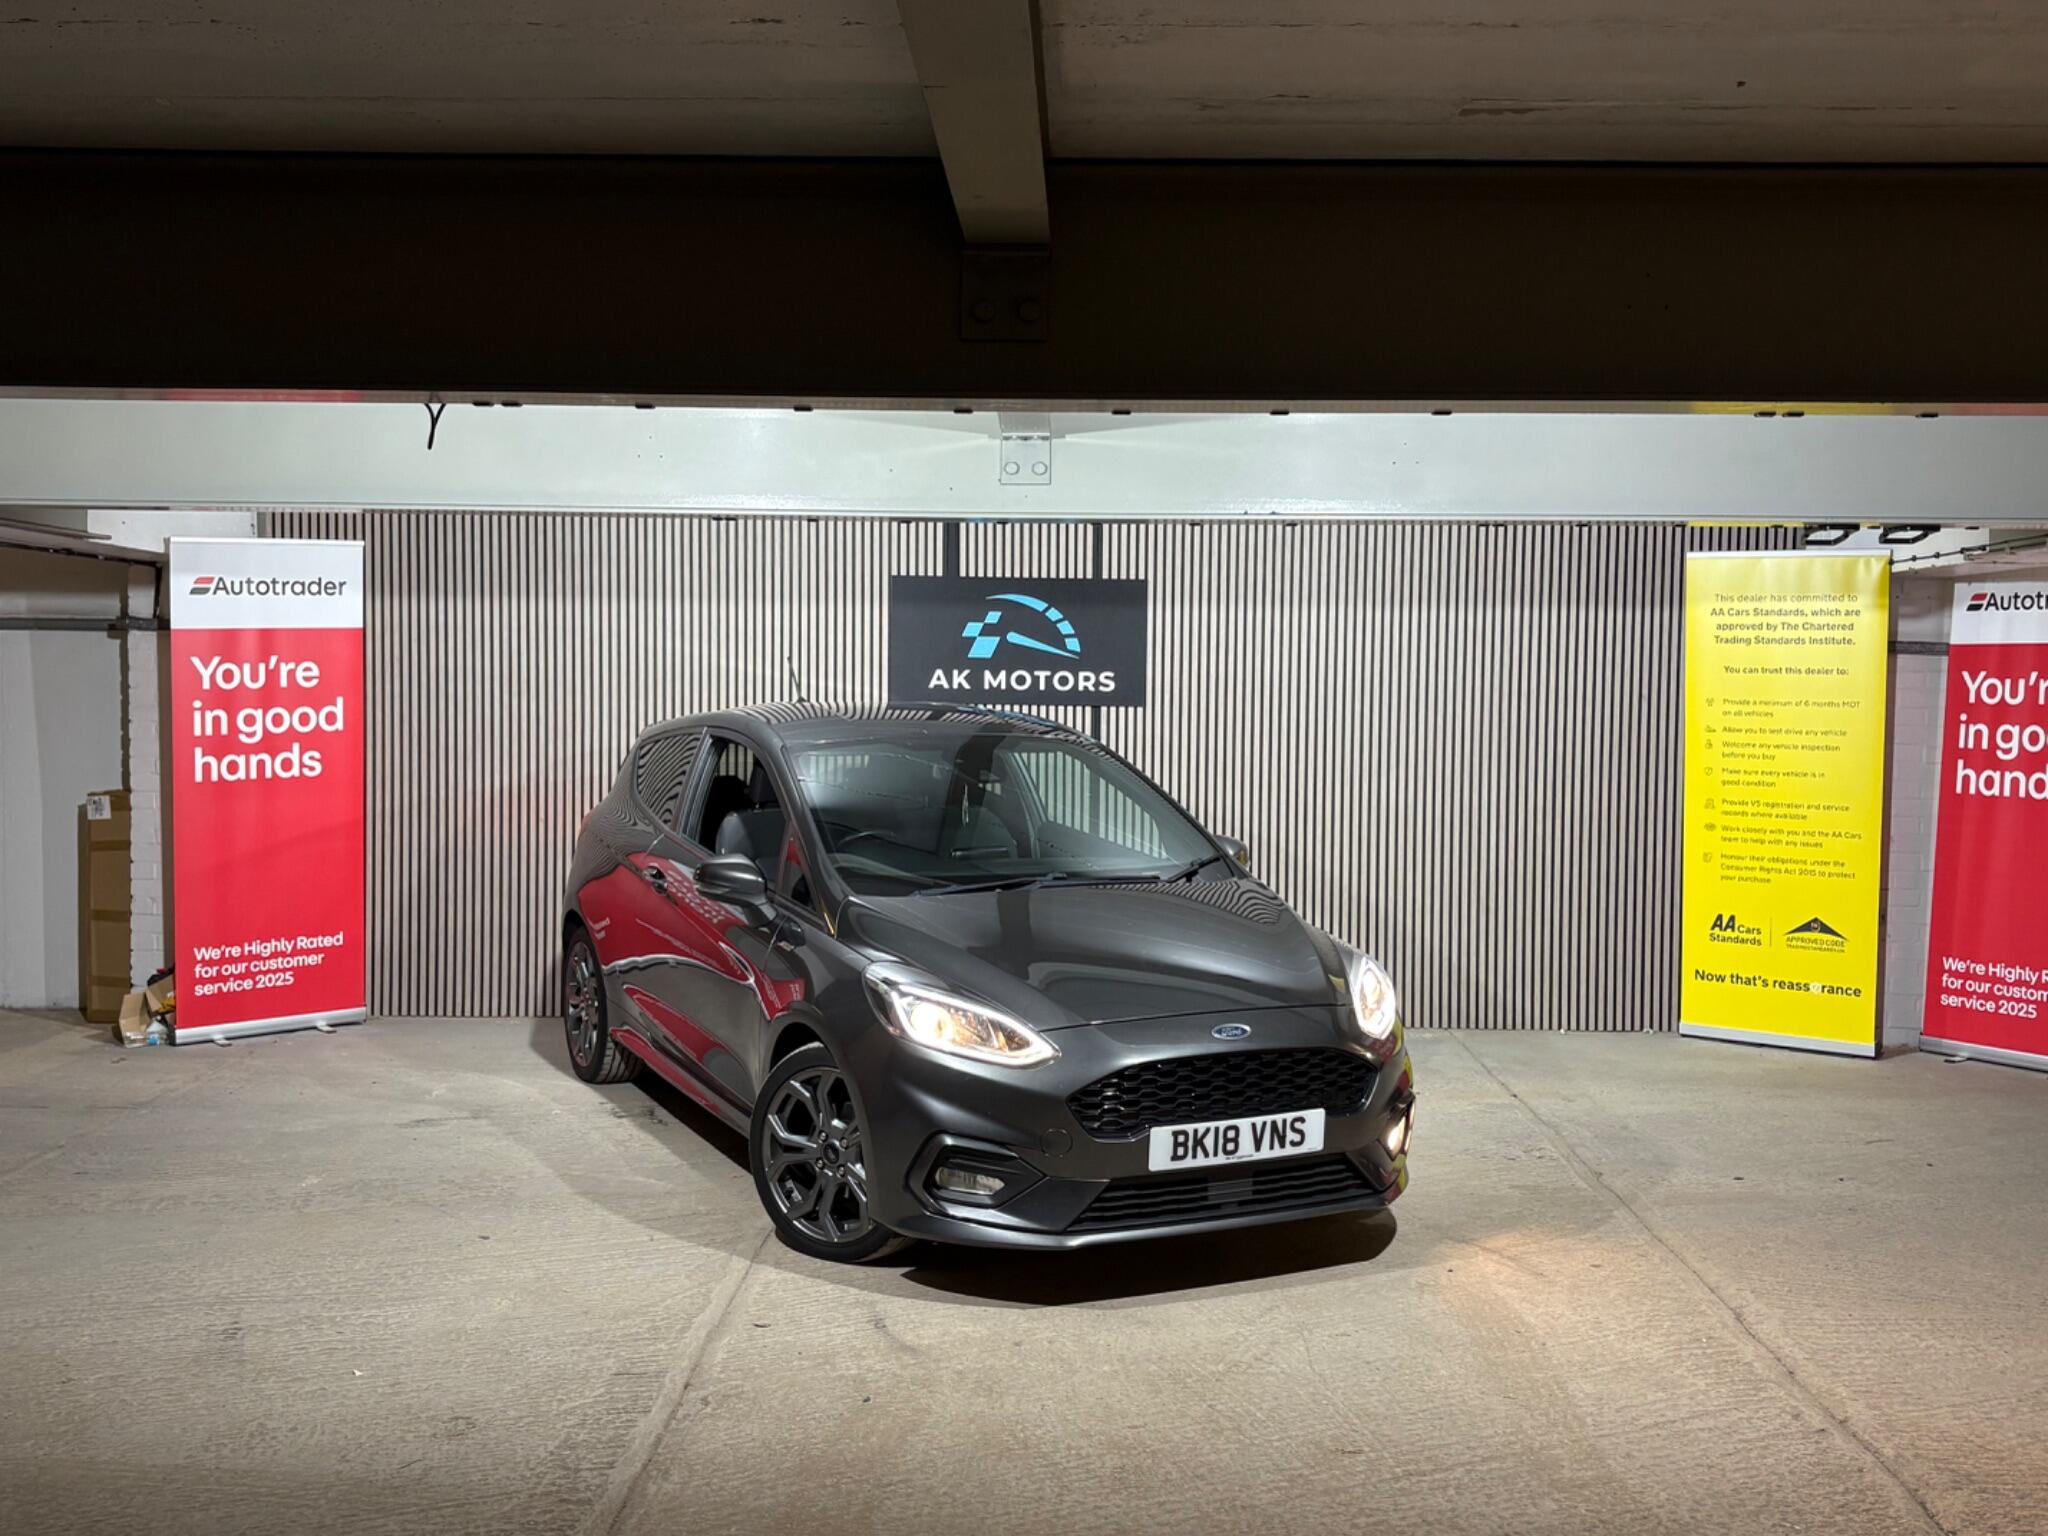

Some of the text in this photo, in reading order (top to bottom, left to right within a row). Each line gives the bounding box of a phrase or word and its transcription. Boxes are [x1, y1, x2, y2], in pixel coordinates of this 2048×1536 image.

[213, 577, 347, 596] Autotrader
[1714, 594, 1735, 602] This
[1737, 594, 1768, 602] dealer
[1771, 594, 1787, 602] has
[1791, 594, 1844, 602] committed
[1728, 608, 1750, 616] Cars
[1753, 608, 1808, 617] Standards,
[1716, 622, 1854, 631] approved by The Chartered
[1714, 635, 1856, 646] Trading Standards Institute.
[190, 655, 320, 690] You're
[928, 669, 1115, 691] AK MOTORS
[1724, 666, 1740, 674] You
[1785, 667, 1802, 675] this
[1805, 667, 1834, 675] dealer
[193, 696, 343, 744] in good
[1959, 713, 2048, 760] in go
[1759, 742, 1771, 750] any
[1773, 742, 1799, 750] vehicle
[1801, 743, 1840, 752] inspection
[1762, 753, 1775, 761] buy
[195, 742, 322, 783] hands
[1722, 799, 1748, 807] Provide
[1763, 801, 1804, 811] registration
[1823, 804, 1850, 812] service
[1743, 826, 1767, 834] closely
[1844, 832, 1862, 840] Cars
[1711, 913, 1761, 935] AA Cars
[194, 931, 343, 960] We're Highly Rated
[1709, 932, 1761, 946] Standards
[195, 953, 324, 978] for our customer
[1943, 957, 1985, 975] We're
[1989, 963, 2039, 985] Highly
[194, 972, 294, 996] service 2025
[1695, 969, 1726, 982] Now
[1731, 973, 1768, 987] that's
[1942, 973, 1963, 989] for
[1966, 981, 1991, 993] our
[1941, 994, 2037, 1019] service 2025
[1170, 1117, 1306, 1162] BK18 VNS
